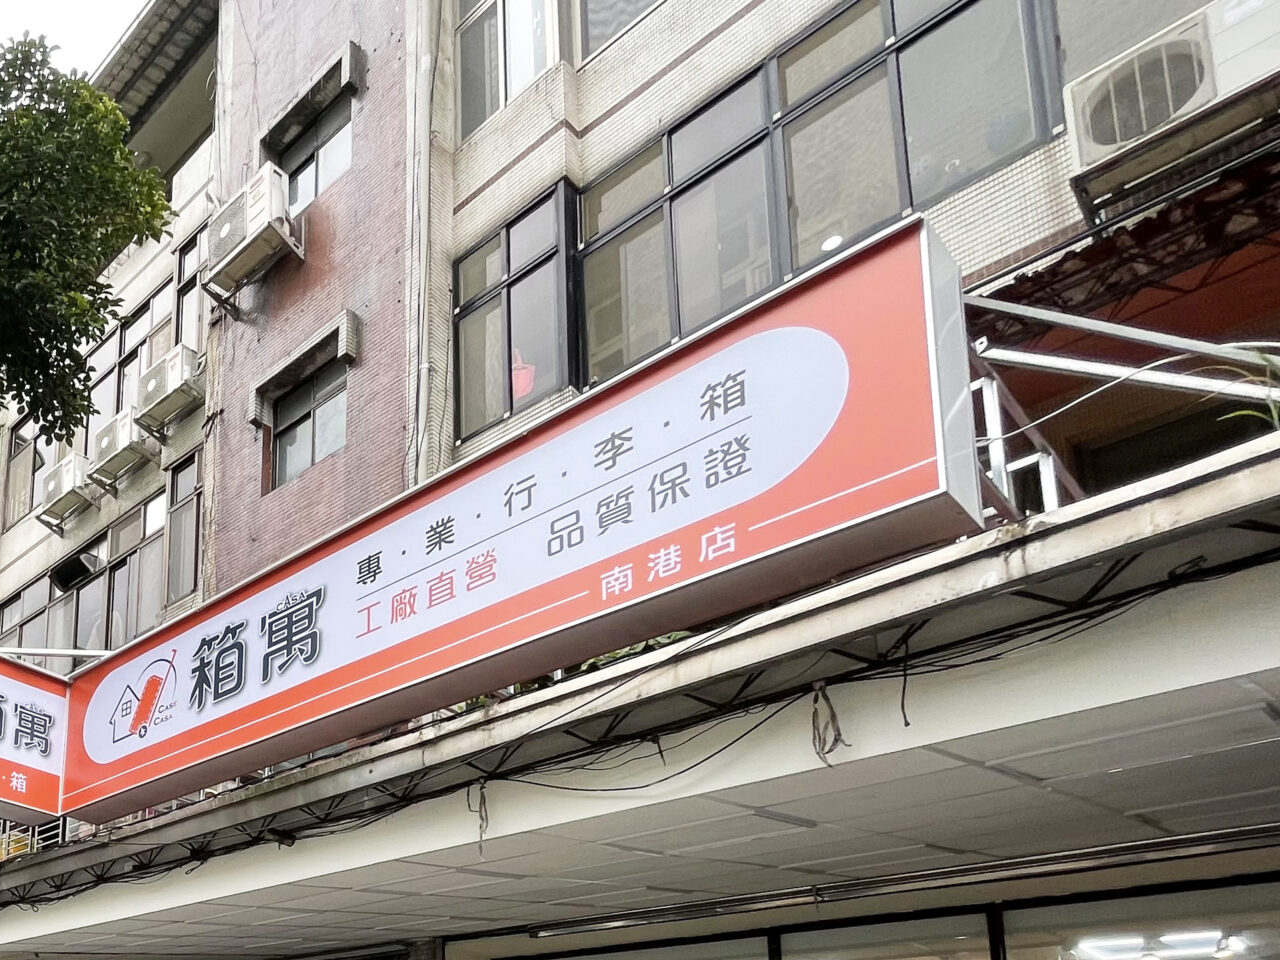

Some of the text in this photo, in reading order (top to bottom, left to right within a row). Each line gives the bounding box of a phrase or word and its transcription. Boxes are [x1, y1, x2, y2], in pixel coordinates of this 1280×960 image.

[355, 433, 753, 639] 工廠直營 品質保證
[599, 522, 738, 602] 南港店
[189, 585, 327, 713] 箱寓
